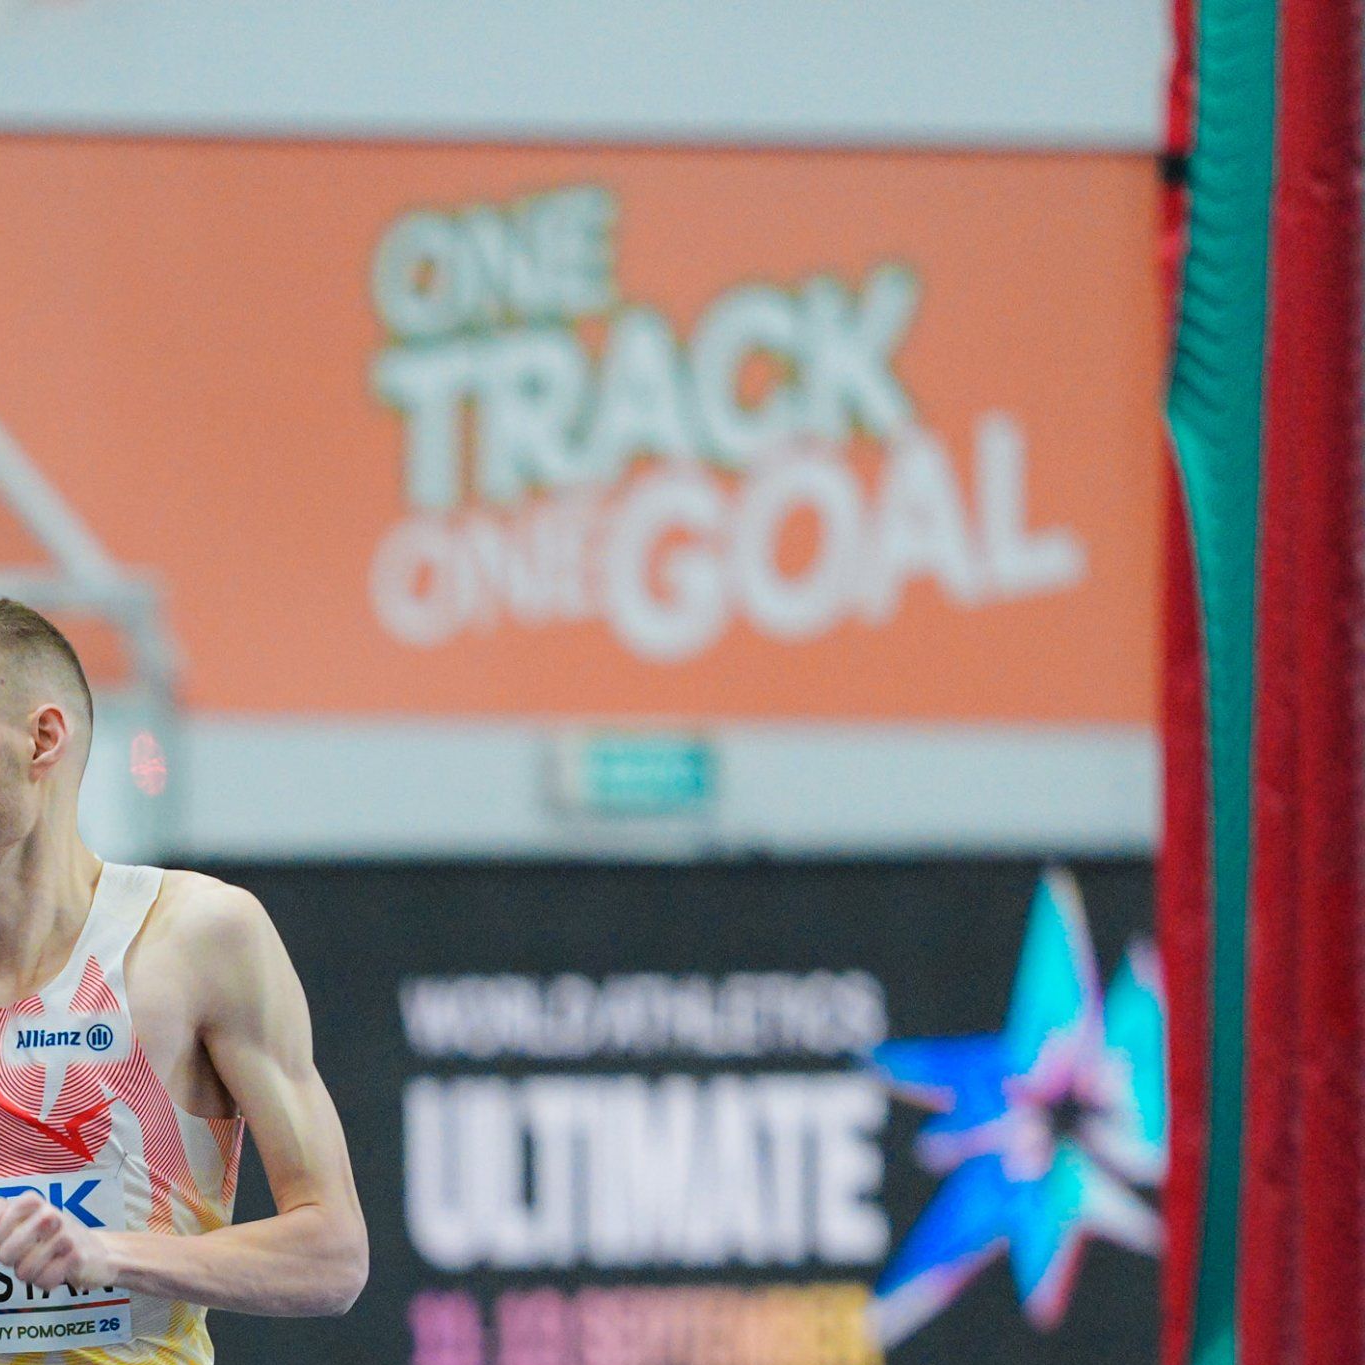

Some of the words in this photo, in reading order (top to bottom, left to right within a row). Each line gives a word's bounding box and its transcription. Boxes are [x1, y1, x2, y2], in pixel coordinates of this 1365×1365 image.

[373, 186, 615, 336] ONE
[376, 264, 921, 508] TRACK
[373, 512, 605, 644] ONE
[609, 412, 1083, 662] GOAL
[16, 1029, 81, 1049] Allianz
[405, 1076, 889, 1268] ULTIMATE
[17, 1320, 96, 1340] POMORZE
[98, 1318, 120, 1331] 26
